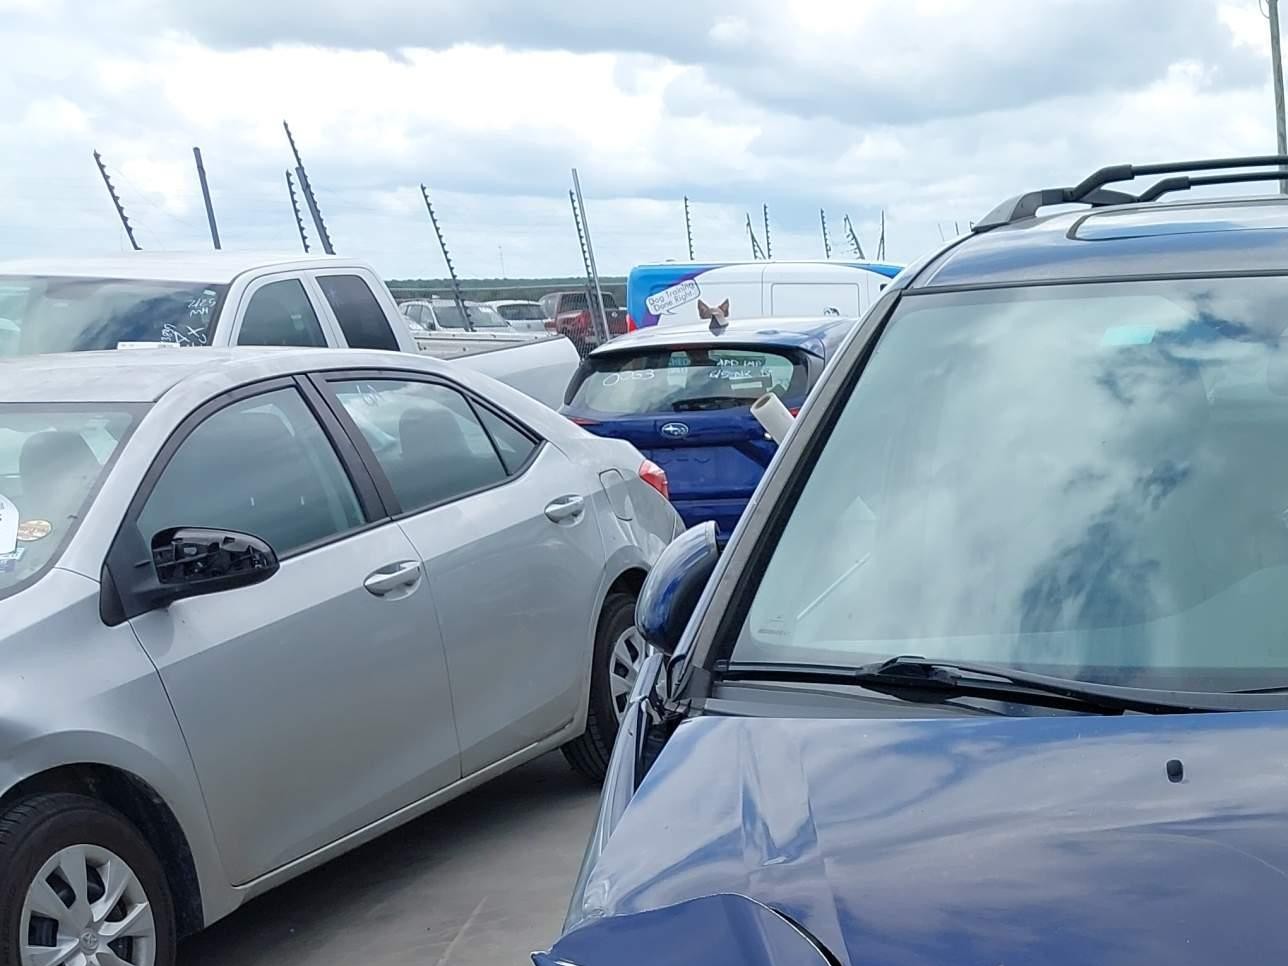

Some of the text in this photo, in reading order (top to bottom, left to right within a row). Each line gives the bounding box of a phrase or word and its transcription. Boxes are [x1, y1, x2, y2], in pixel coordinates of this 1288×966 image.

[649, 282, 696, 306] Dog Training
[653, 299, 674, 312] Done
